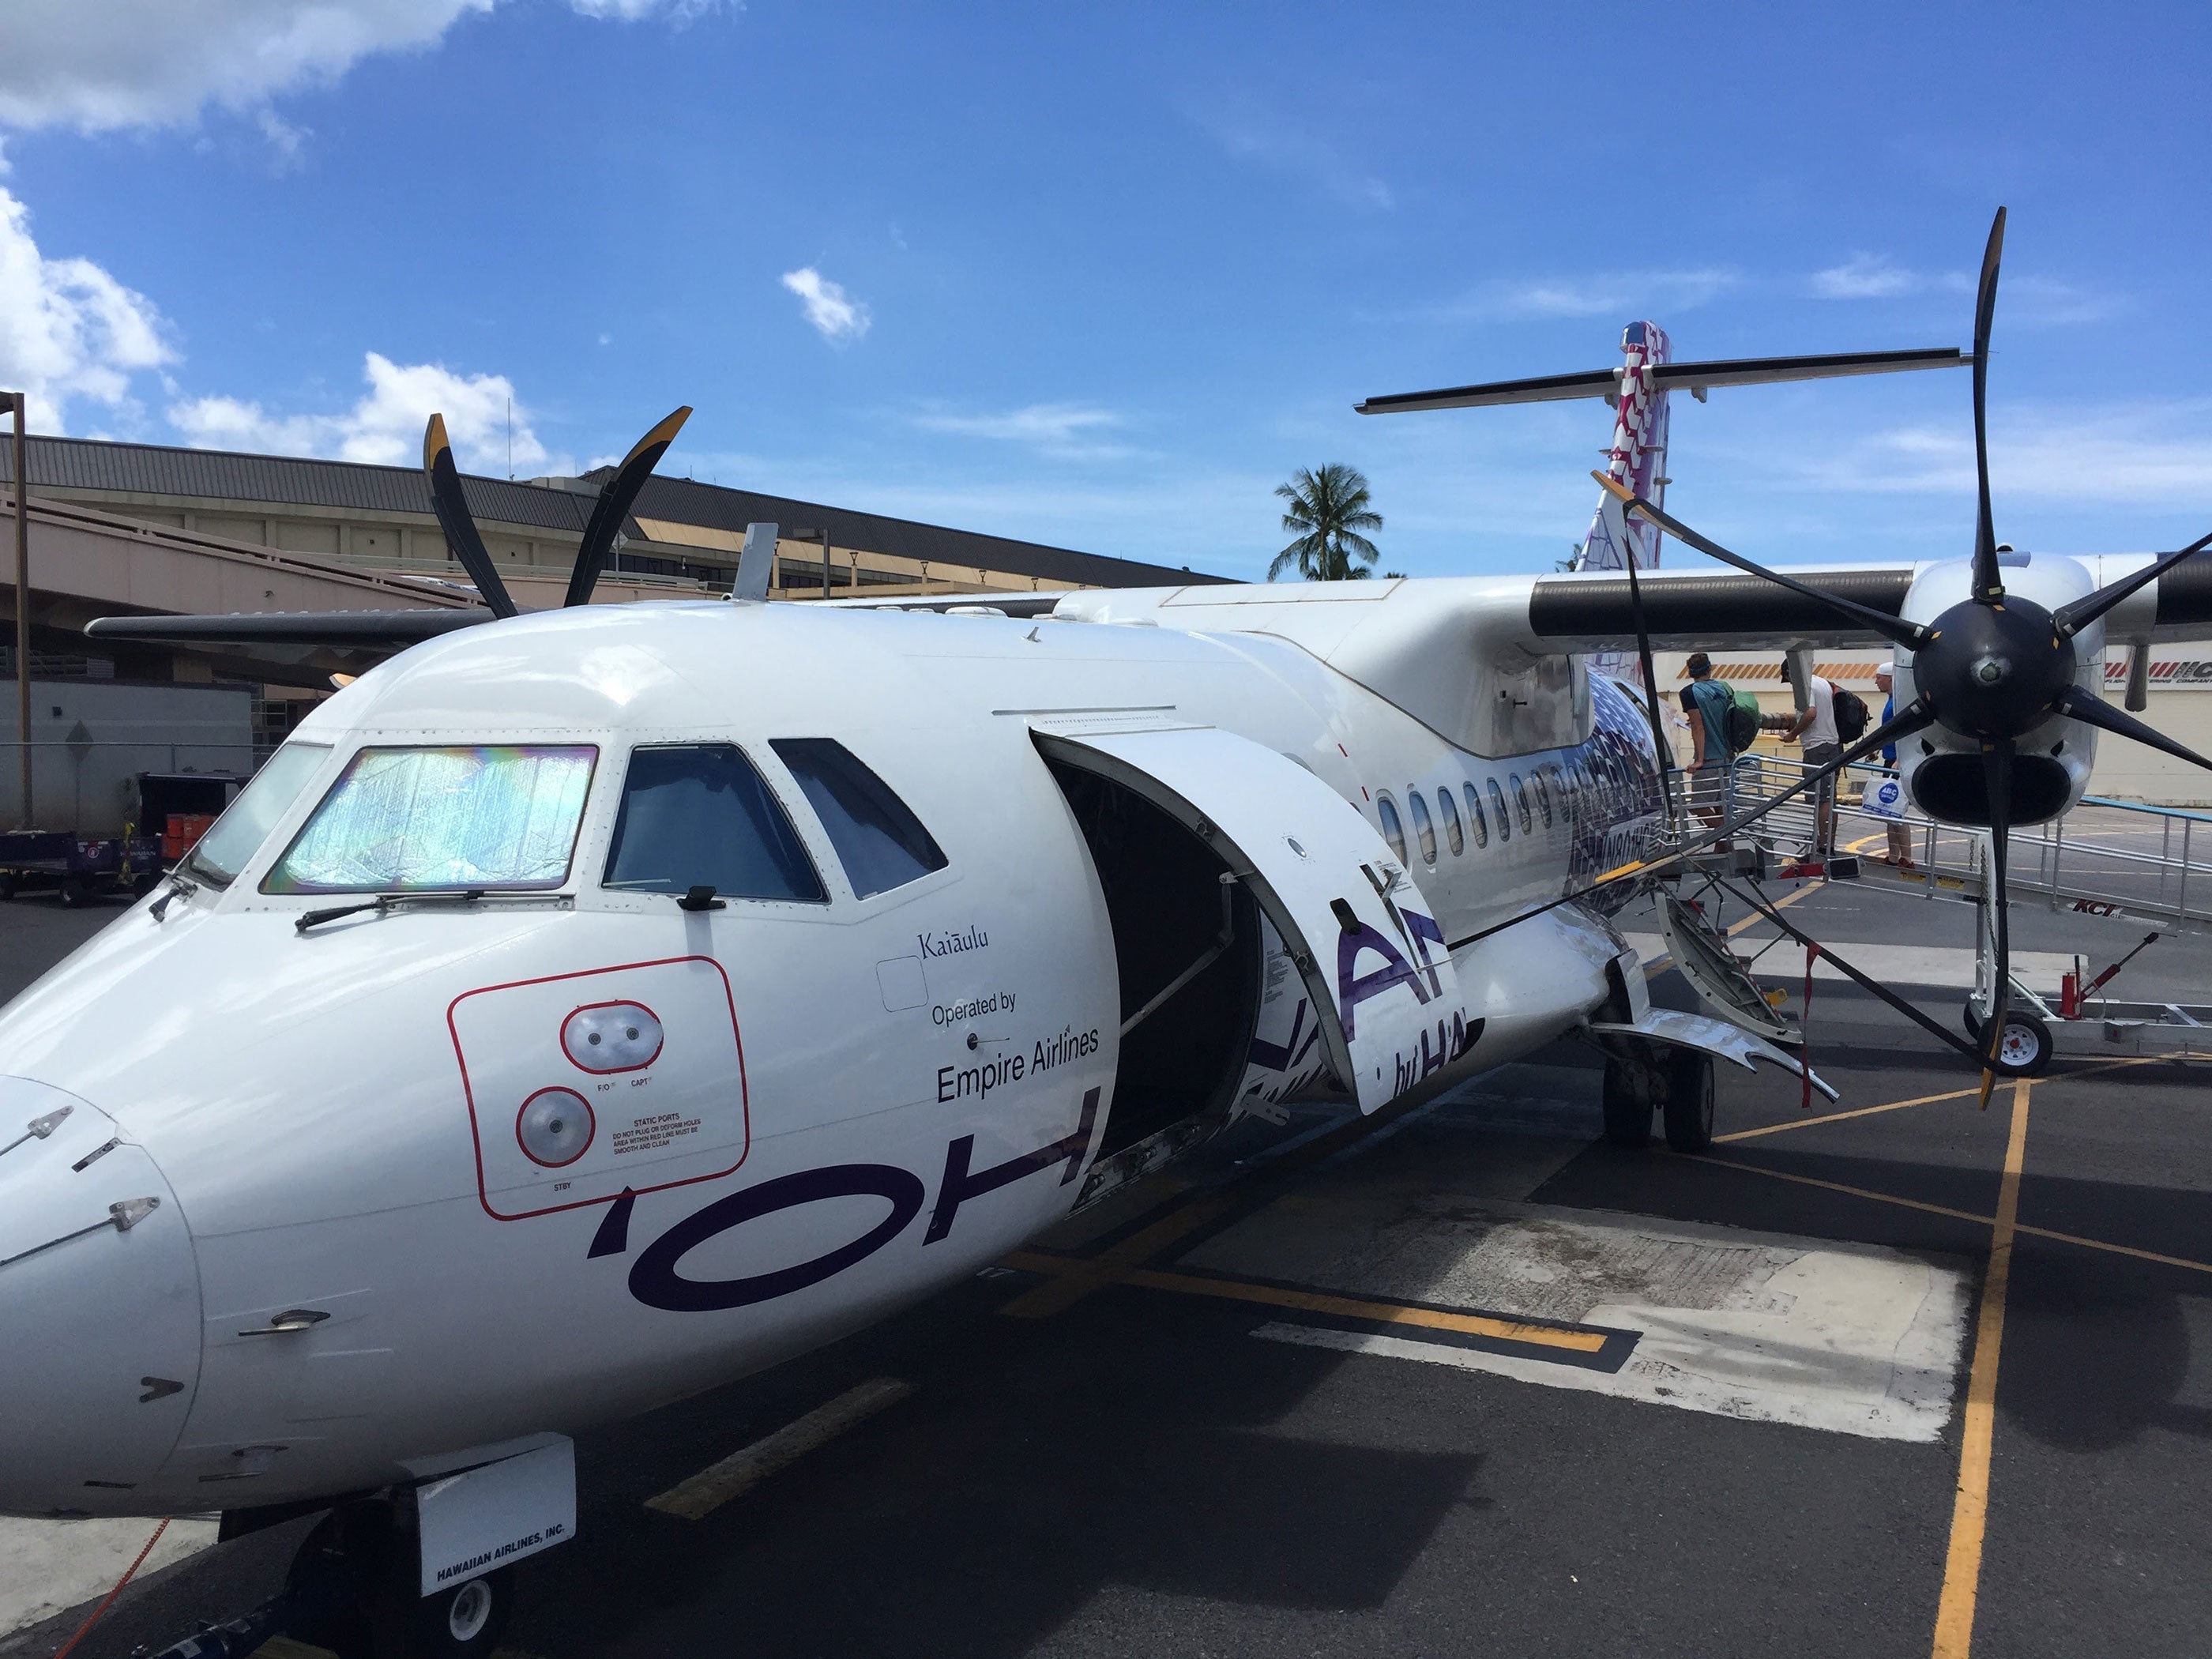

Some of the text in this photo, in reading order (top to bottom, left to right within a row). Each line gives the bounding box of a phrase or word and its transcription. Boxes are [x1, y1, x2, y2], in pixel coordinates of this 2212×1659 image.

[917, 924, 989, 960] Kaiāulu
[932, 991, 1016, 1028] Operated by
[938, 1028, 1099, 1104] Empire Airlines
[631, 1078, 648, 1087] CAPT
[634, 1112, 680, 1127] STATIC PORTS
[635, 1127, 650, 1136] PLUG
[660, 1122, 683, 1131] DEFORM
[683, 1119, 702, 1127] HOLES
[630, 1134, 649, 1144] WITHIN
[675, 1127, 690, 1136] MUST
[614, 1146, 638, 1155] SMOOTH
[652, 1139, 670, 1148] CLEAN
[554, 1181, 571, 1191] STBY
[437, 1524, 565, 1582] HAWAIIAN AIRLINES, INC.
